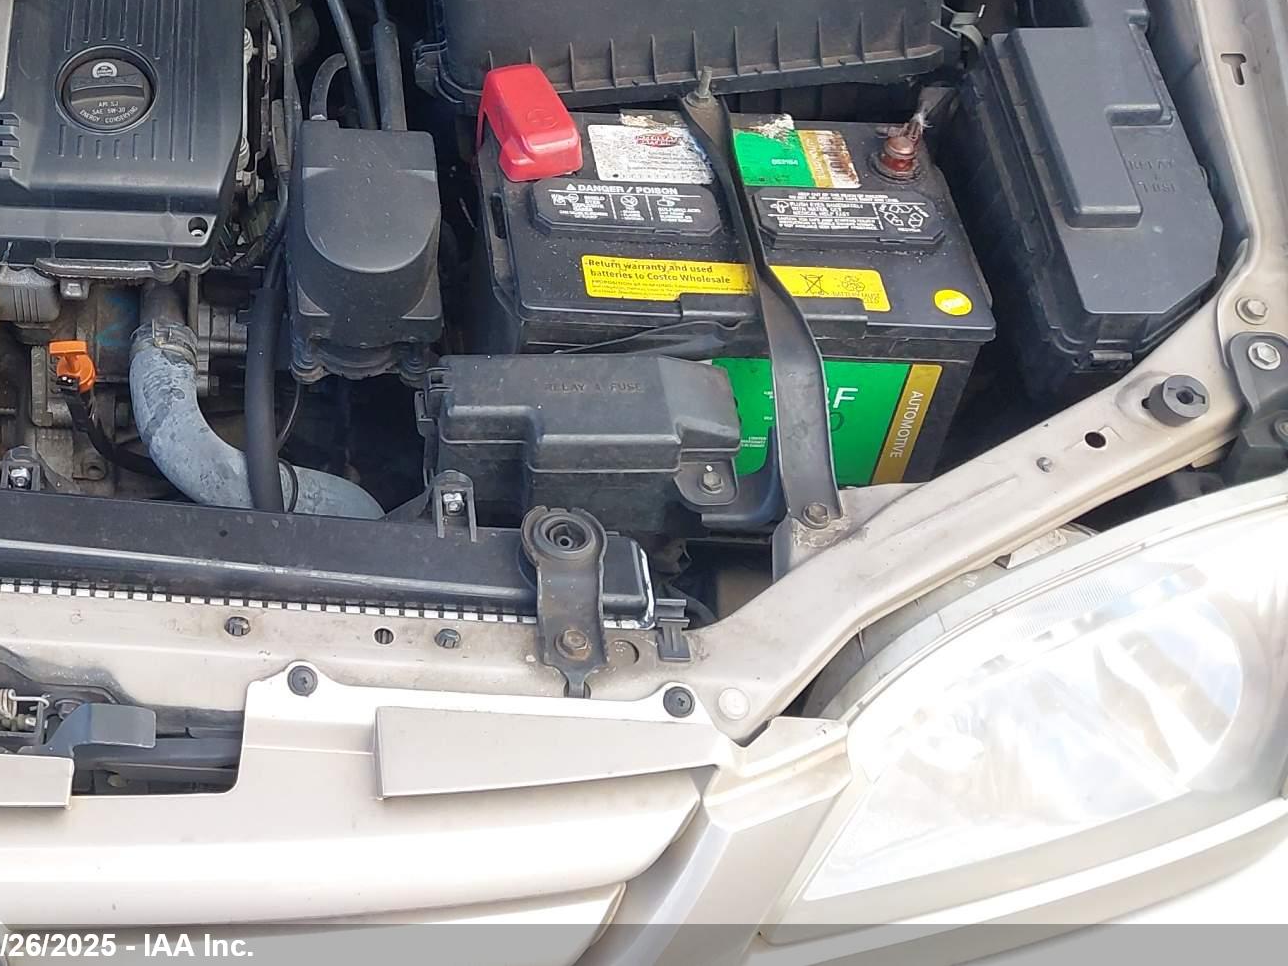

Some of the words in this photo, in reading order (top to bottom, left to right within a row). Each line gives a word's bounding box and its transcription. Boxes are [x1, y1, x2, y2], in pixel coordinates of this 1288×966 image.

[79, 109, 101, 122] ENERGY
[105, 105, 139, 124] CONSERVING
[578, 184, 624, 193] DANGER
[636, 186, 679, 195] POISON
[588, 259, 621, 269] Return
[623, 261, 667, 273] warranty
[669, 264, 688, 273] and
[689, 265, 713, 274] used
[590, 268, 633, 279] batteries
[635, 272, 645, 280] to
[647, 272, 678, 281] Costco
[679, 274, 731, 284] Wholesale
[889, 390, 924, 459] AUTOMOTIVE
